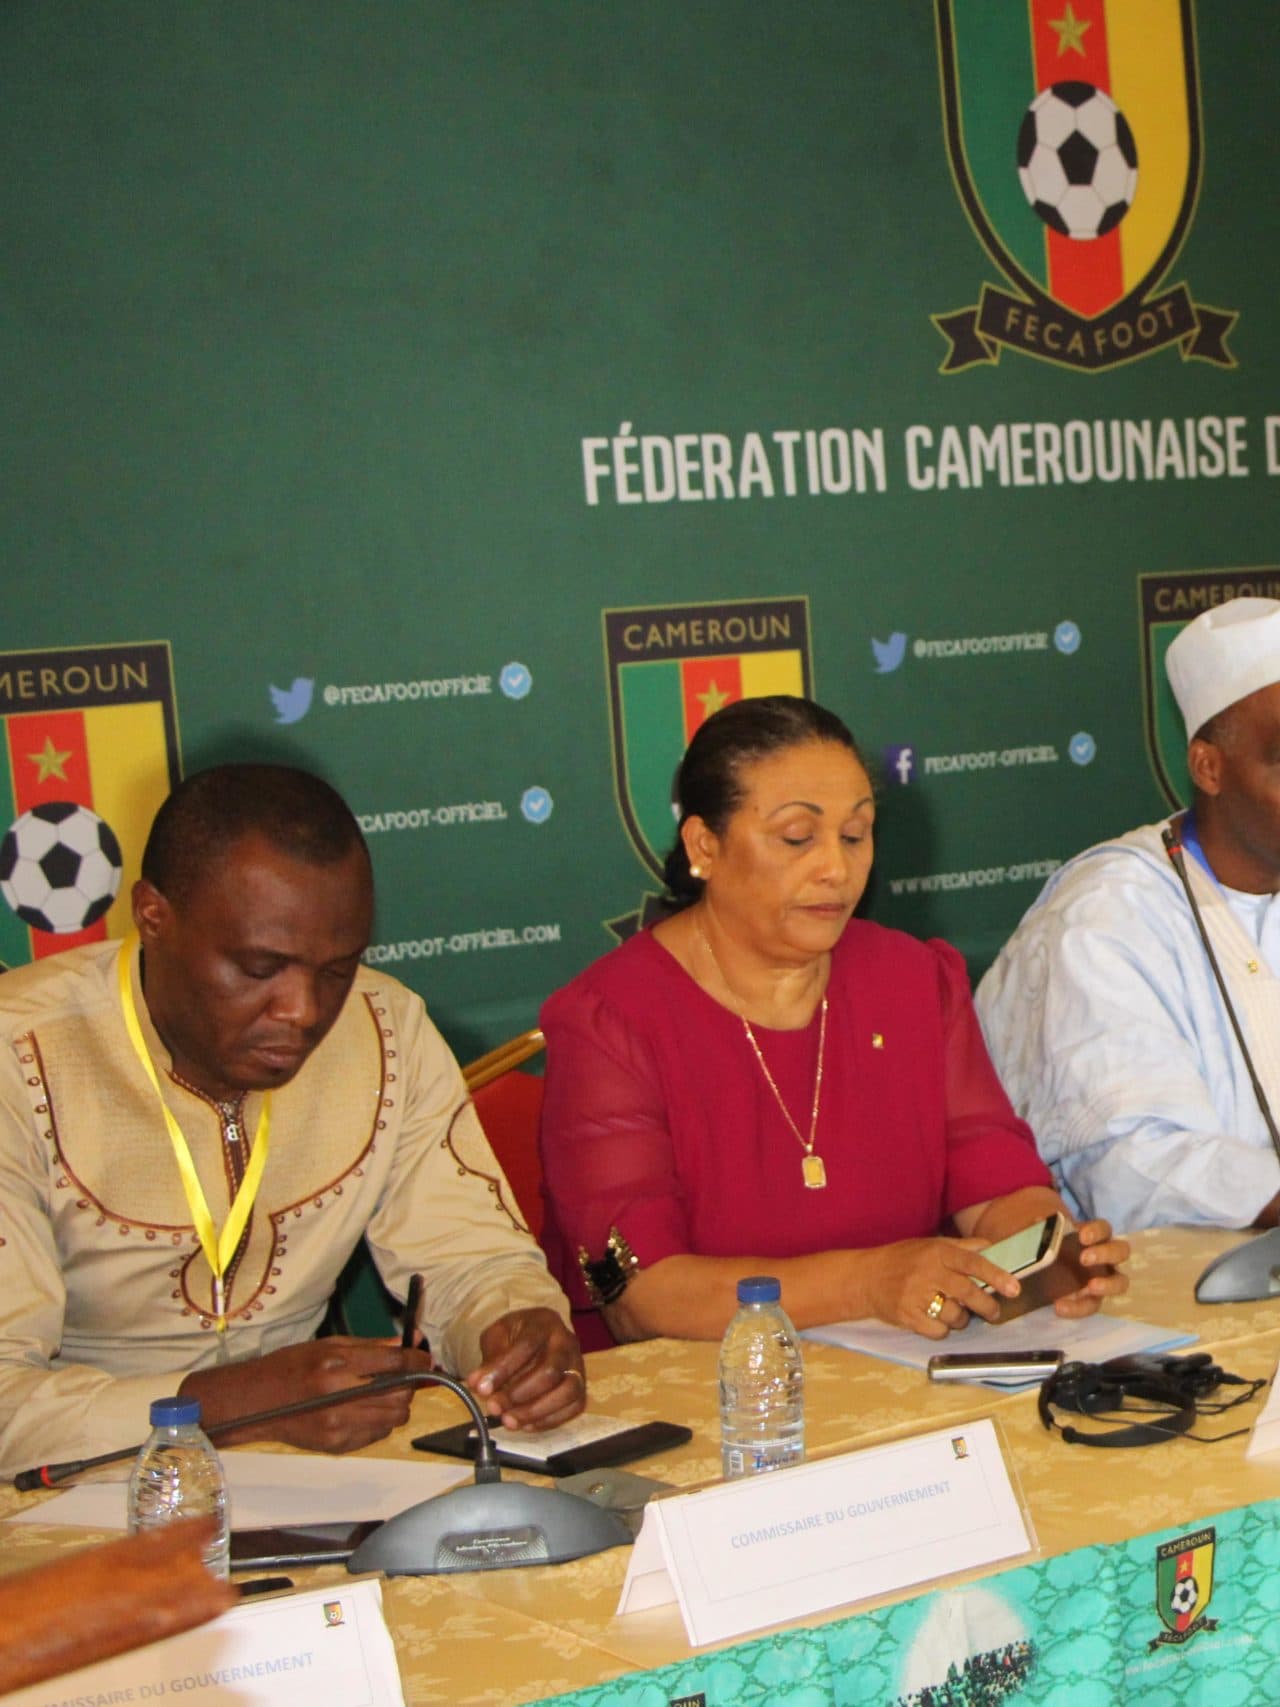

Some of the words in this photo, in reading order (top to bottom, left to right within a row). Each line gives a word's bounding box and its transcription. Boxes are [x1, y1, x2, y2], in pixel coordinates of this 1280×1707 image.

[1004, 301, 1176, 357] FECAFOOT
[582, 421, 885, 506] FÉDERATION
[904, 416, 1248, 492] CAMEROUNAISE
[623, 614, 791, 650] CAMEROUN
[362, 923, 561, 964] ECAFOOT-OFFICIEL.COM
[730, 1511, 823, 1550] COMMISSAIRE
[825, 1506, 845, 1527] DU
[848, 1479, 952, 1519] GOUVERNEMENT
[1160, 1531, 1212, 1557] CAMEROUN
[139, 1682, 166, 1699] DU
[170, 1651, 314, 1693] GOUVERNEMENT
